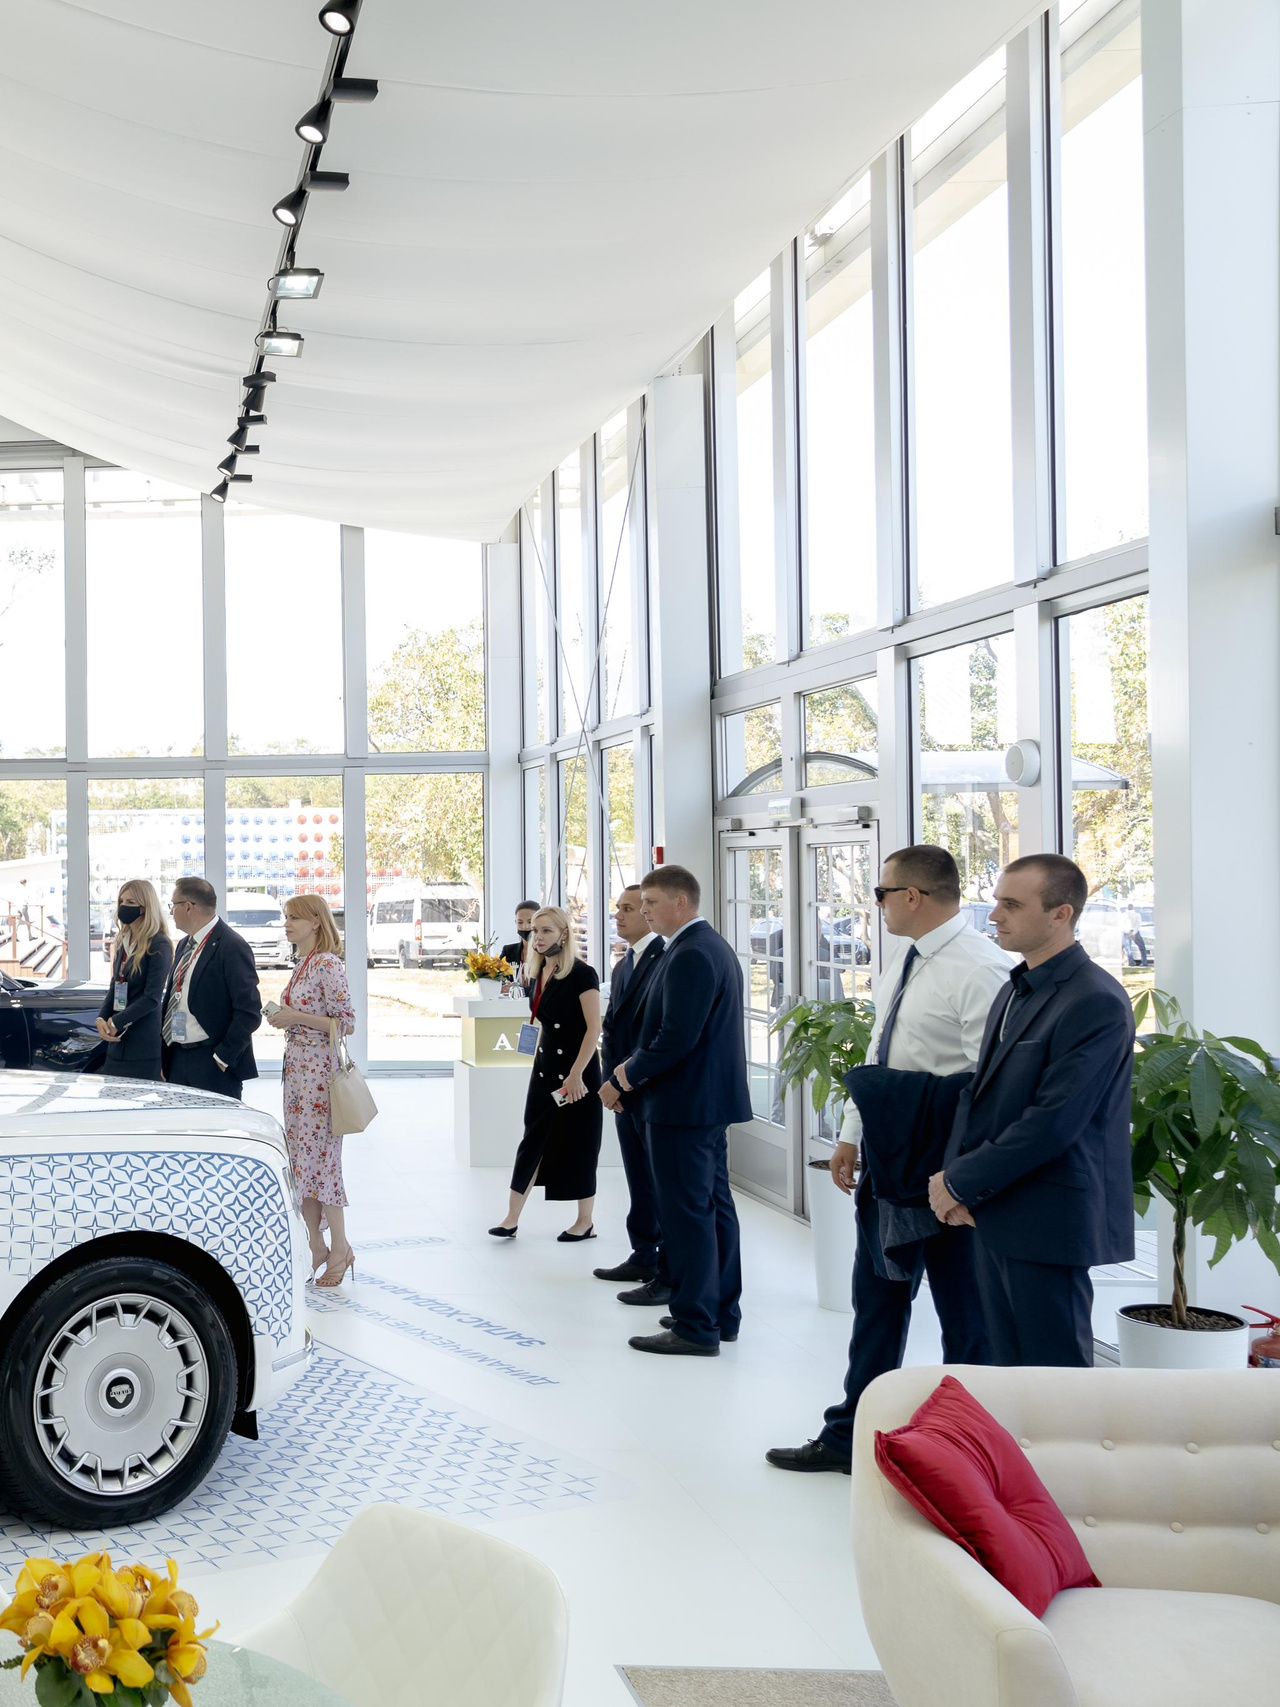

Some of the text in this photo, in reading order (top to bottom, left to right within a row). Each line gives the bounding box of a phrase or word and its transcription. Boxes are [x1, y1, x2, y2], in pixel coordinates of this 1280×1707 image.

[492, 1033, 520, 1051] A
[402, 1294, 470, 1318] ХОДА
[456, 1316, 546, 1348] ЗАПАС
[385, 1320, 560, 1386] ДИНАМИЧЕСКИЕ
